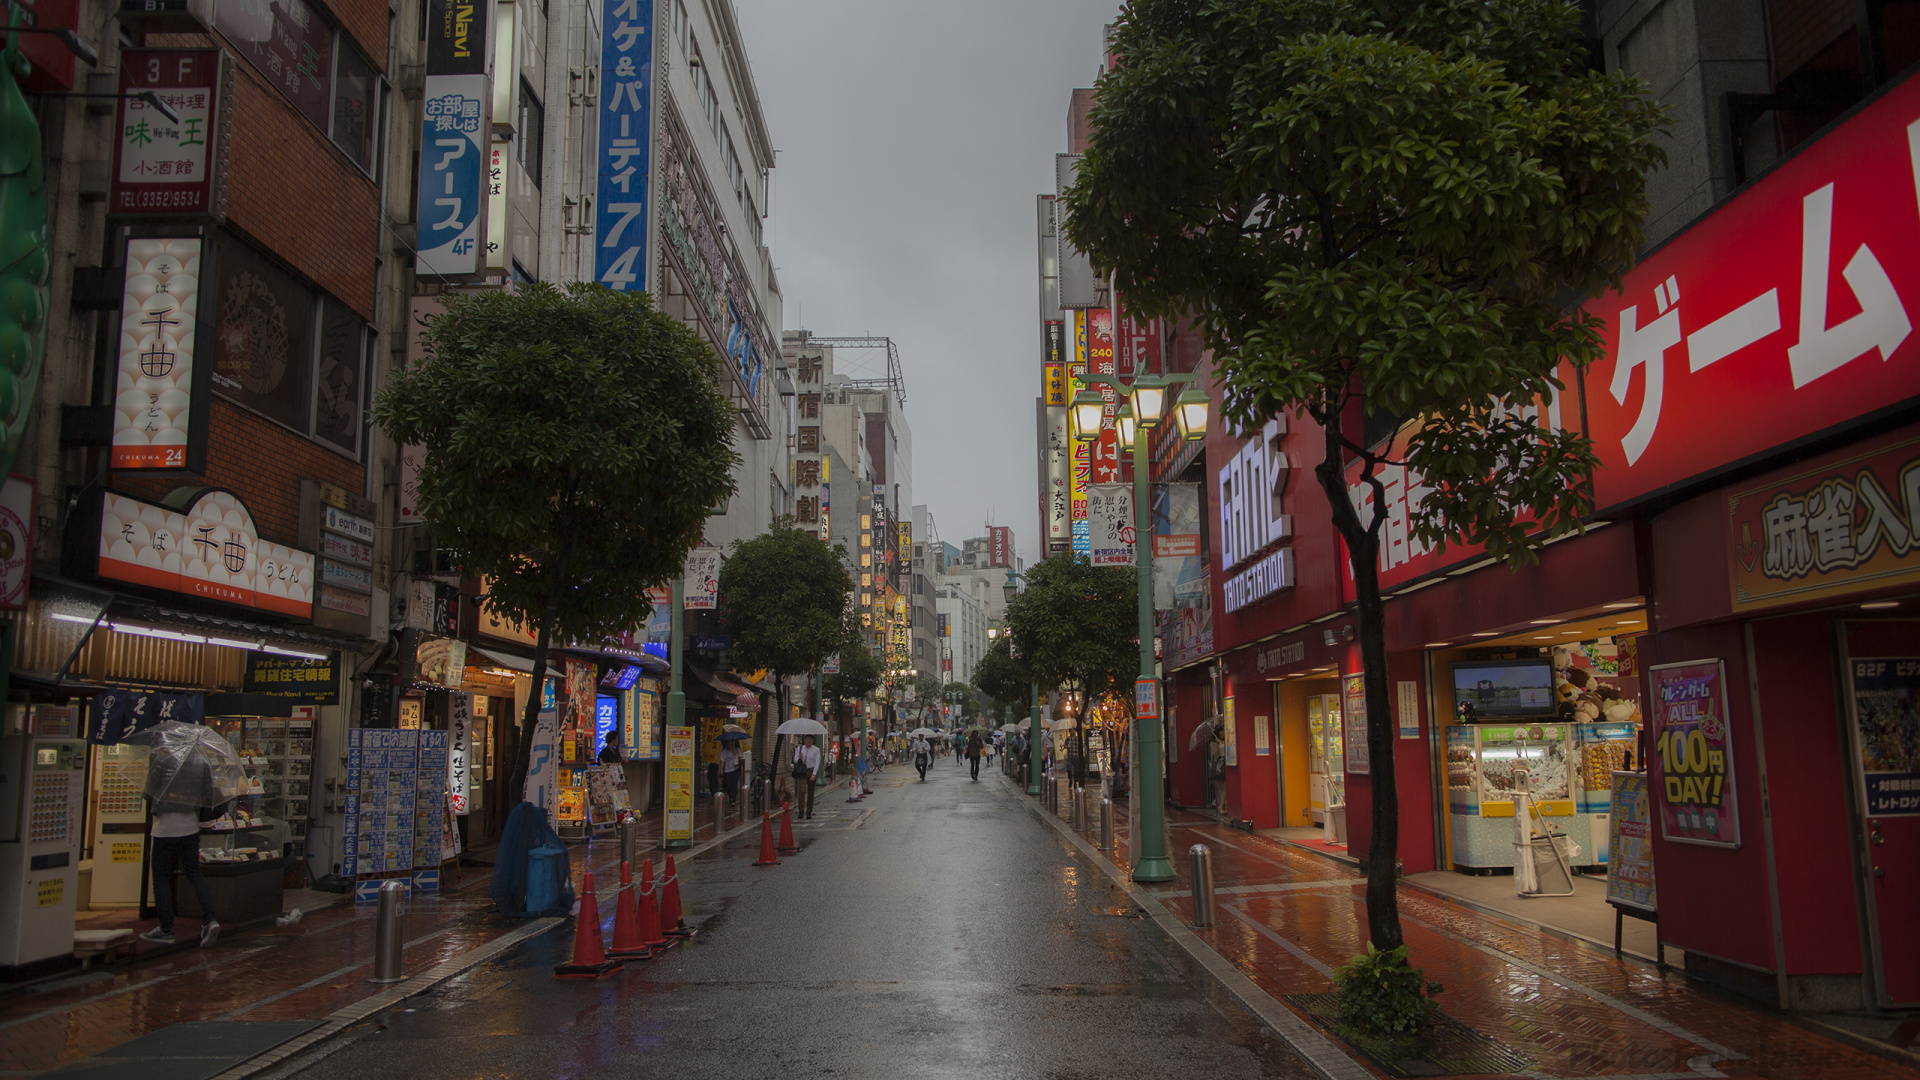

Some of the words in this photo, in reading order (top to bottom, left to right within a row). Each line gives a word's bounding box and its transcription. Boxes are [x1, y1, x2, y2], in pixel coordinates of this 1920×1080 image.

[148, 59, 160, 82] 3
[178, 59, 192, 82] F
[427, 95, 480, 119] お部屋
[126, 118, 152, 148] 味
[179, 119, 204, 146] 王
[435, 114, 478, 132] 探しは
[133, 160, 194, 175] 小酒館
[433, 138, 466, 231] アース
[451, 239, 474, 255] 4F
[156, 263, 171, 294] そば
[1609, 116, 1920, 468] ゲーム
[1091, 349, 1112, 357] 240
[1098, 362, 1116, 430] 海居酒屋
[145, 394, 159, 432] うどん
[166, 449, 182, 461] 24
[1054, 490, 1065, 521] 大江戸
[1219, 415, 1288, 573] GAME
[1092, 496, 1103, 518] 街に。
[1104, 496, 1117, 540] 思いやりの
[1766, 465, 1920, 573] 麻雀入
[339, 516, 357, 532] earth
[121, 524, 167, 551] そば
[267, 561, 299, 584] うどん
[350, 541, 370, 563] 味王
[1094, 548, 1133, 556] 新宿区内全域
[1094, 556, 1132, 564] 路上喫煙禁止
[196, 583, 242, 600] CHIKUMA
[1223, 572, 1246, 614] TAITO
[1247, 550, 1285, 604] STATION
[1281, 641, 1304, 665] STATION
[1856, 663, 1886, 678] B2F
[1668, 702, 1702, 722] ALL
[1488, 732, 1510, 741] LINE
[1657, 729, 1724, 775] 100円
[1664, 775, 1721, 805] DAY!
